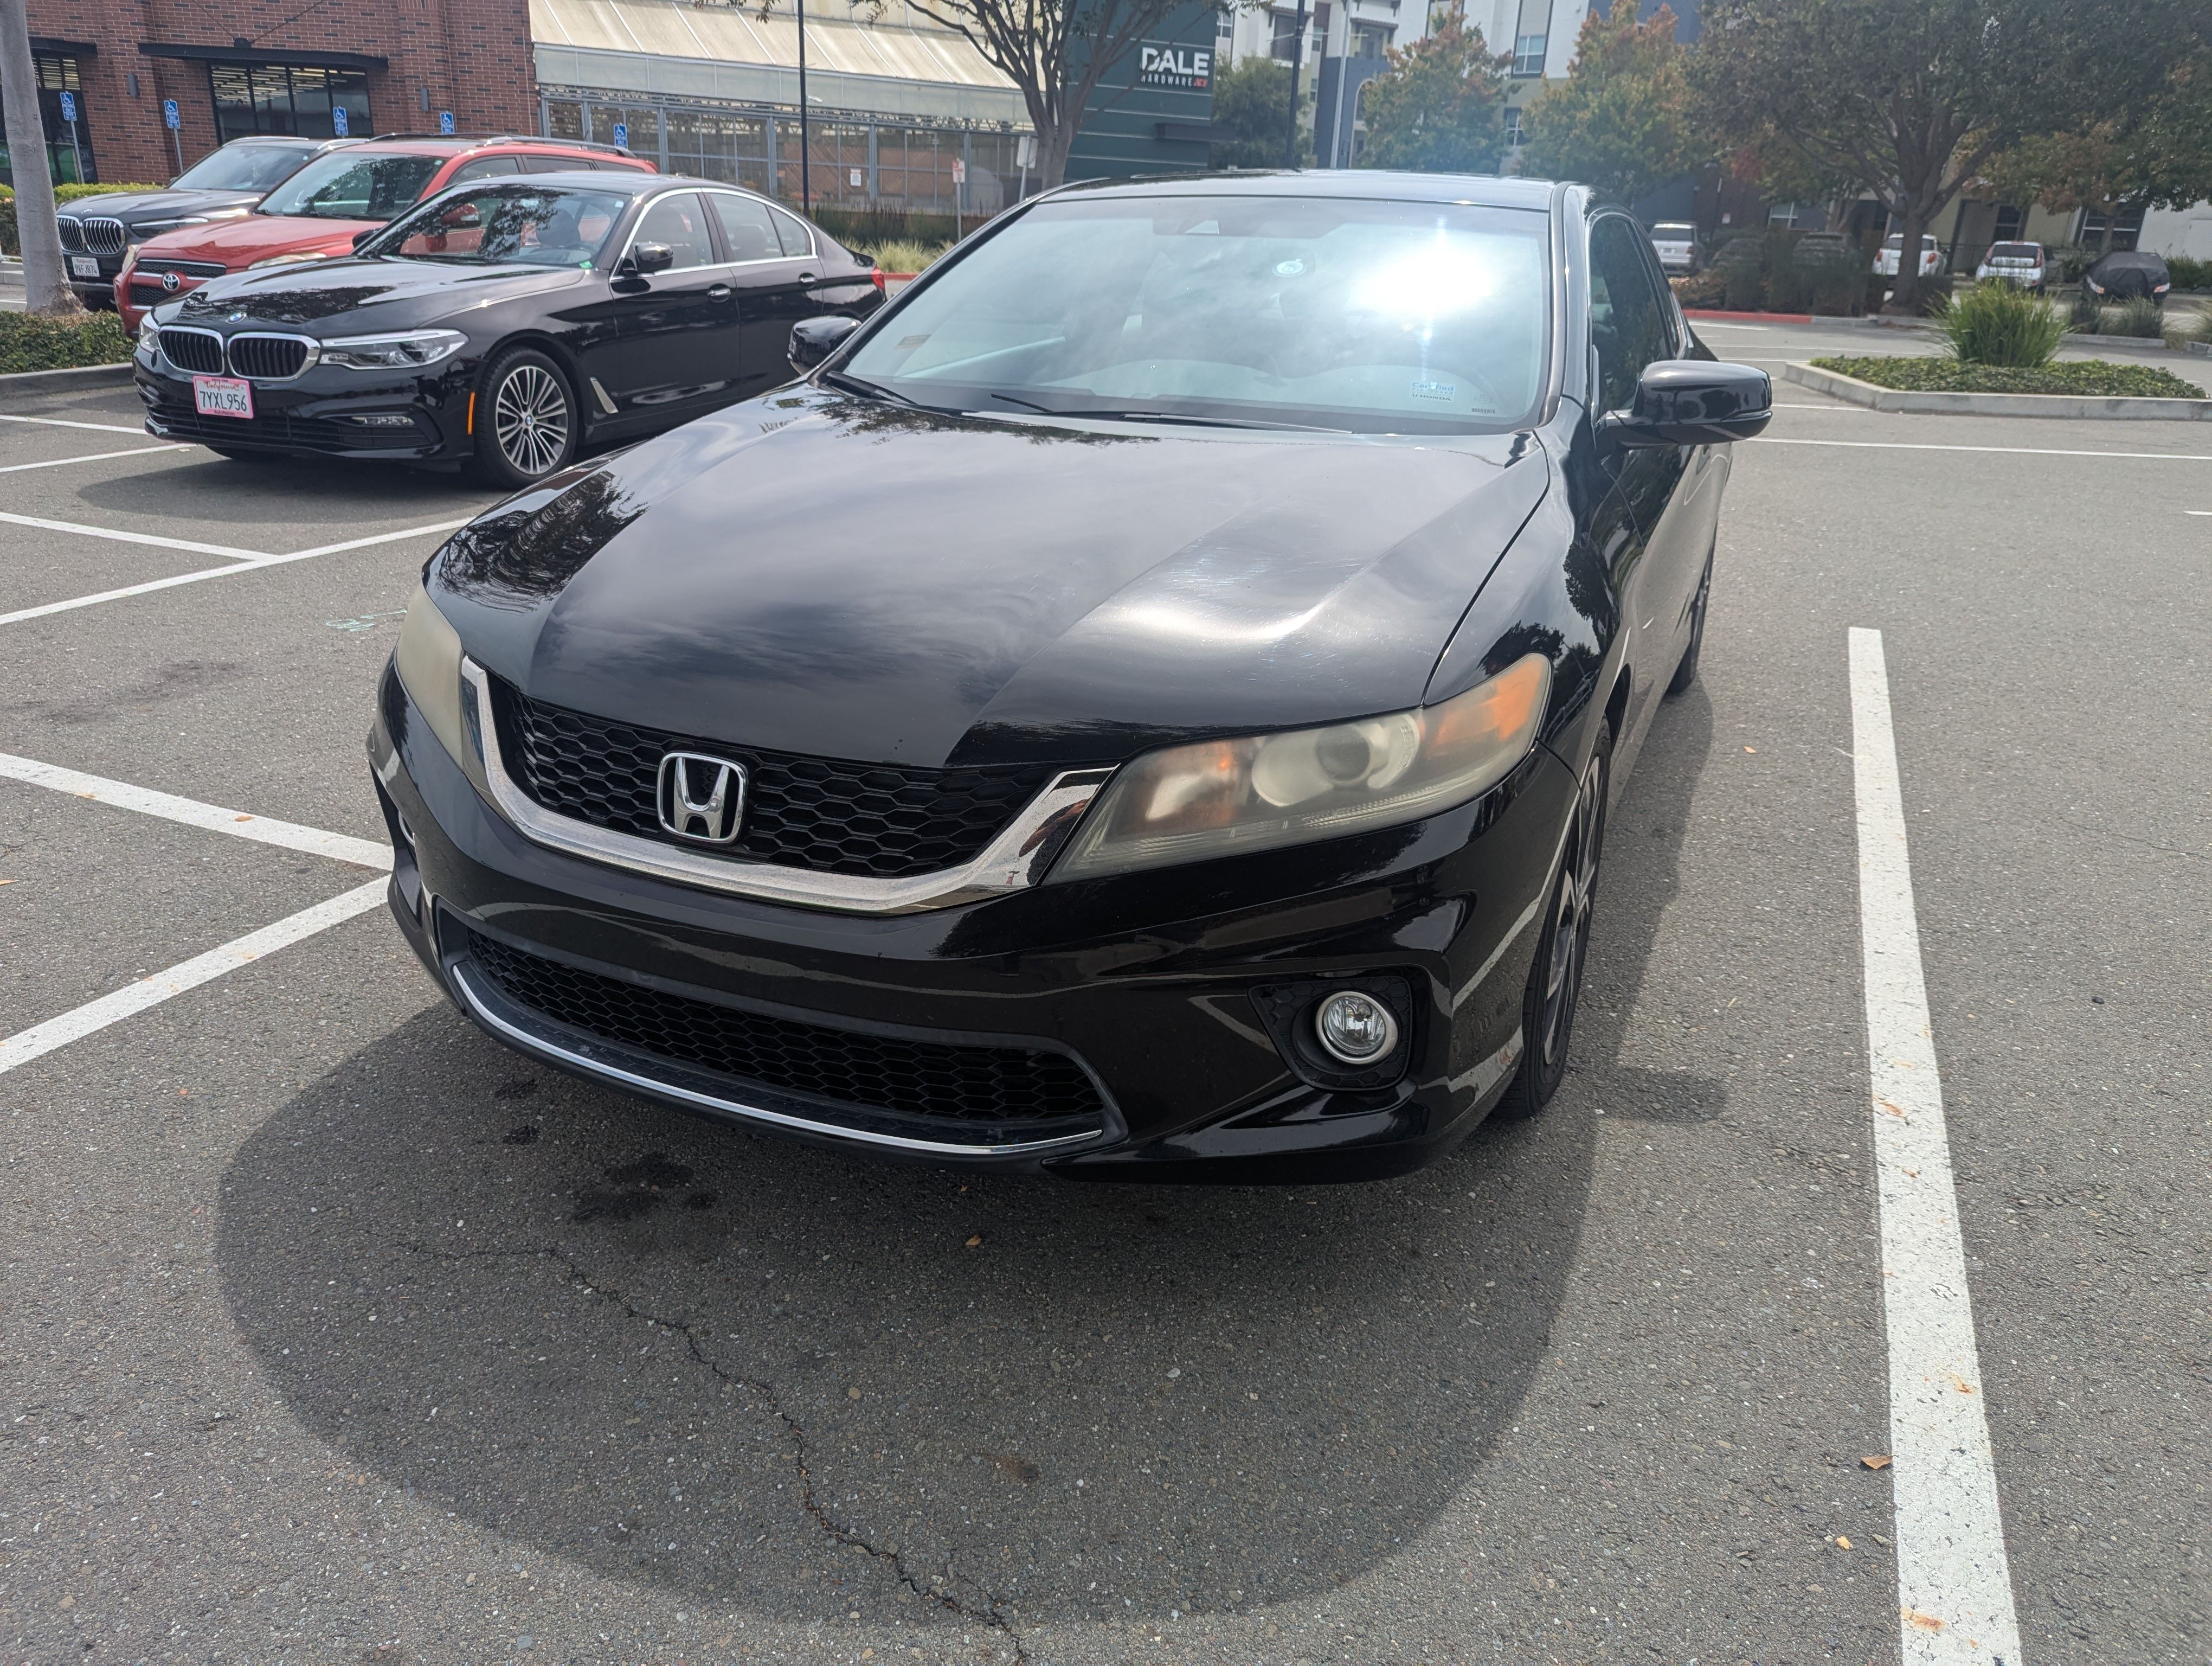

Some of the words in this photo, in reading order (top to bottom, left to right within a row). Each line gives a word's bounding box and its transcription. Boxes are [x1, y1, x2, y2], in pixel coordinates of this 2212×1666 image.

[1142, 47, 1210, 76] DALE
[1141, 74, 1192, 87] HARDWARE
[207, 380, 239, 391] California
[200, 390, 247, 412] 7YXL956
